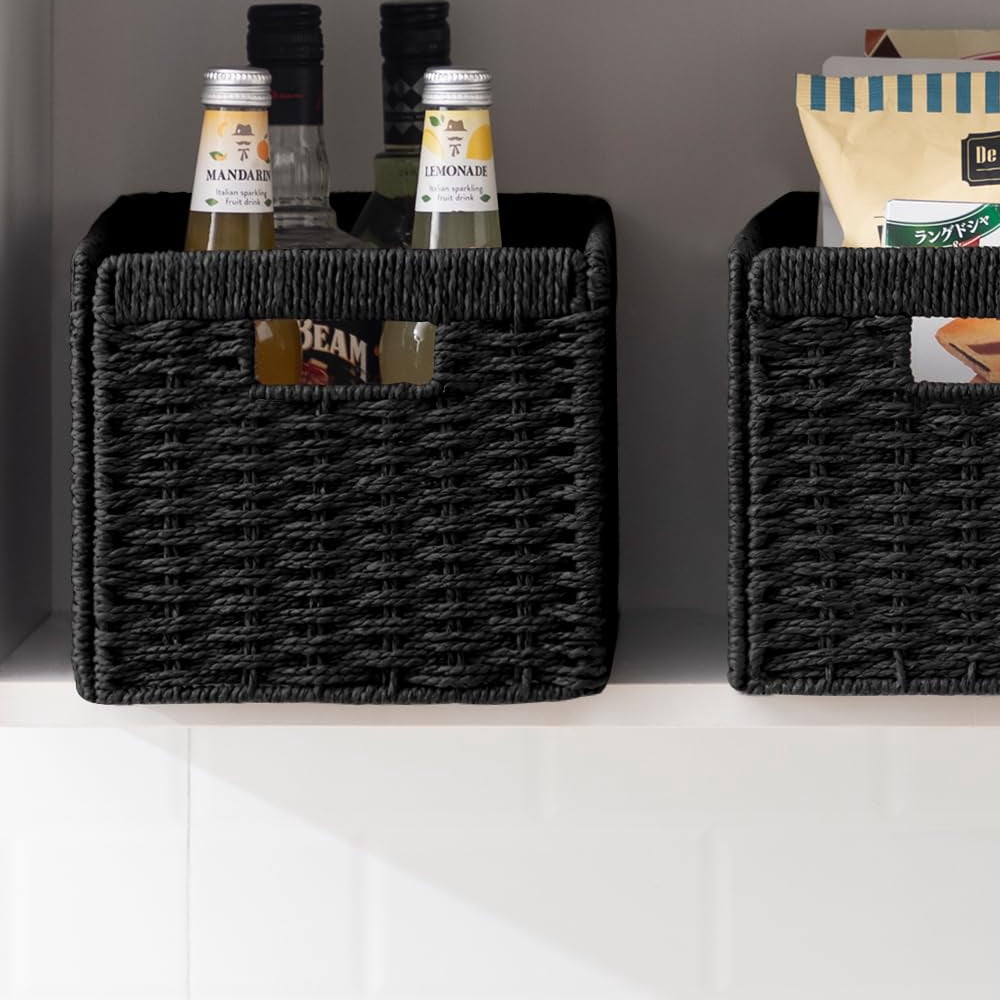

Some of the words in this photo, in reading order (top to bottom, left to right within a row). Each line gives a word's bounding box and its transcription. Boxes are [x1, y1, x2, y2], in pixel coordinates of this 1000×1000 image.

[975, 146, 997, 164] De
[425, 165, 488, 177] LEMONADE
[240, 189, 268, 199] sparkling
[451, 184, 484, 194] sparkling
[244, 198, 261, 206] drink
[455, 193, 474, 201] drink
[914, 215, 990, 246] ラングドシャ
